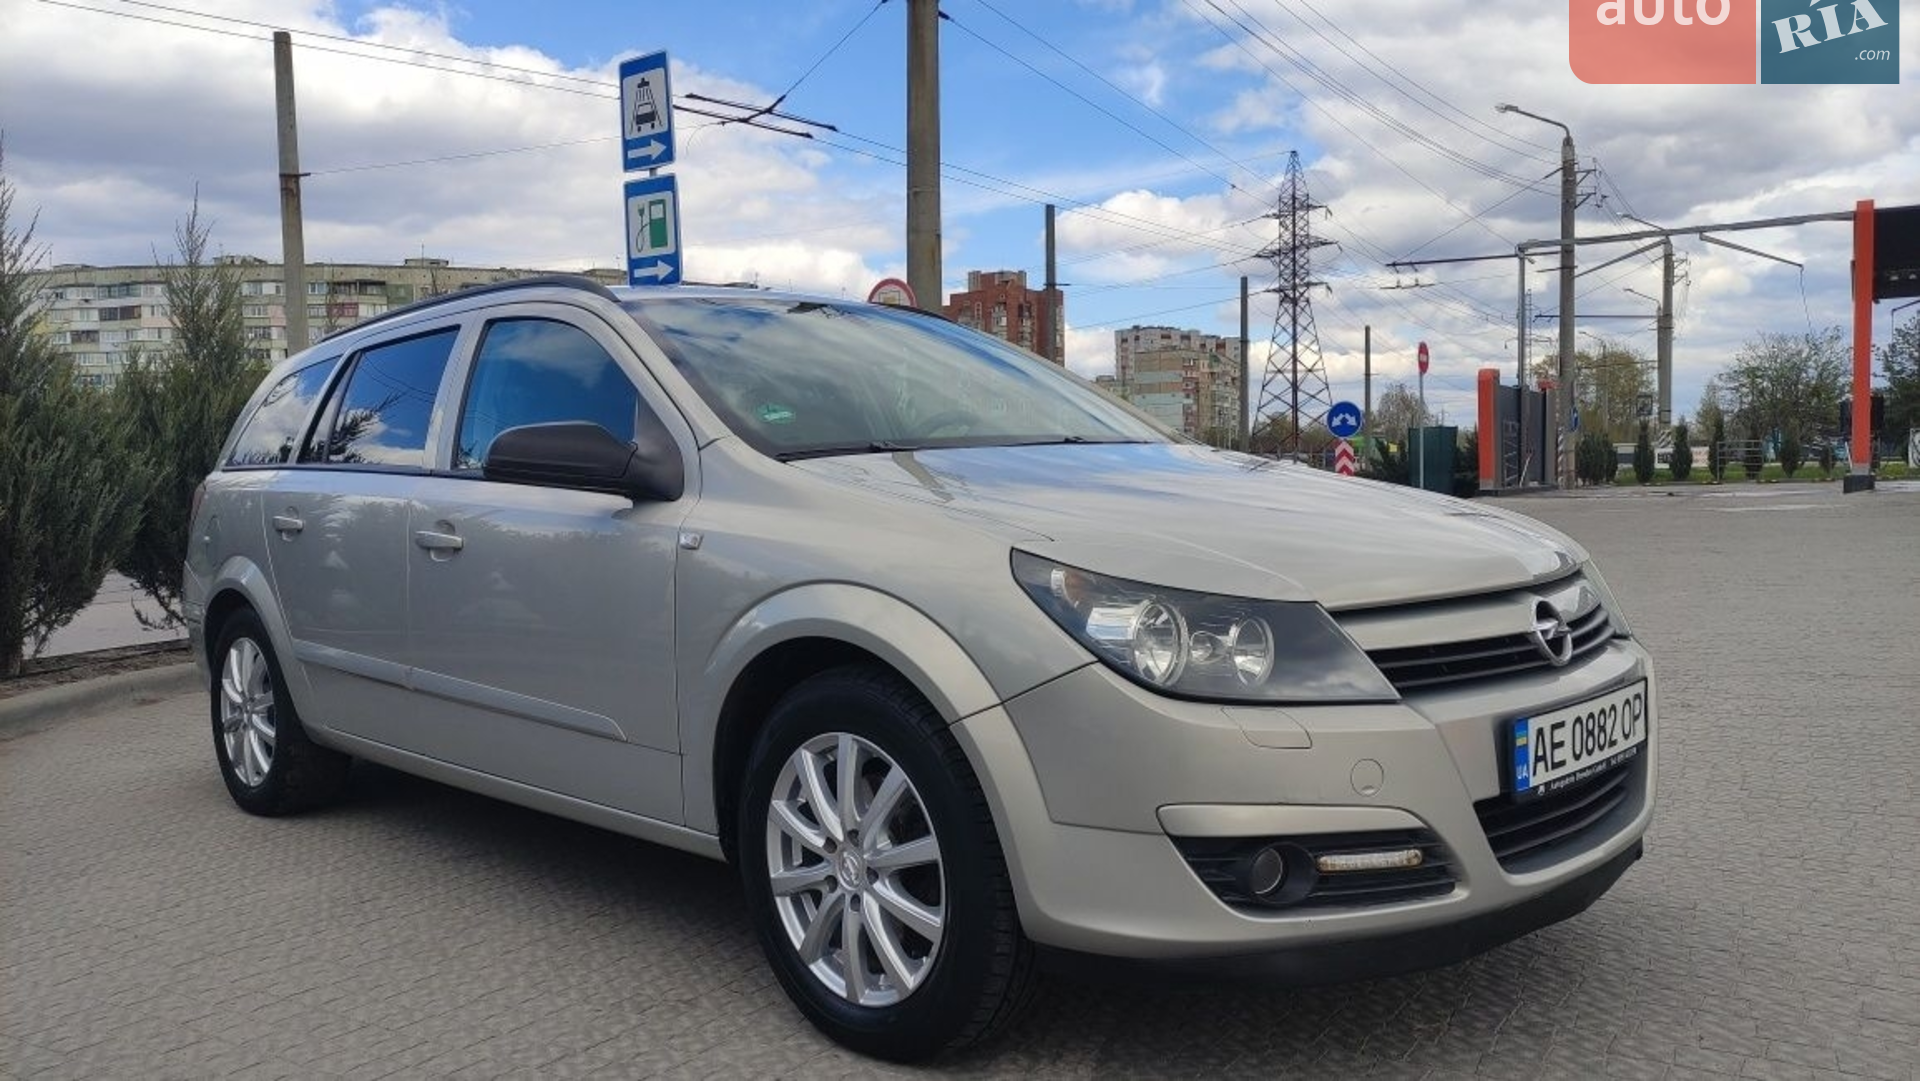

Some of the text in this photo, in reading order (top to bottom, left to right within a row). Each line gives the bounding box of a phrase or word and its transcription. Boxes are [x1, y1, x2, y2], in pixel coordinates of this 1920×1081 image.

[1533, 692, 1643, 777] AE 0882 OP
[1516, 764, 1529, 780] UA
